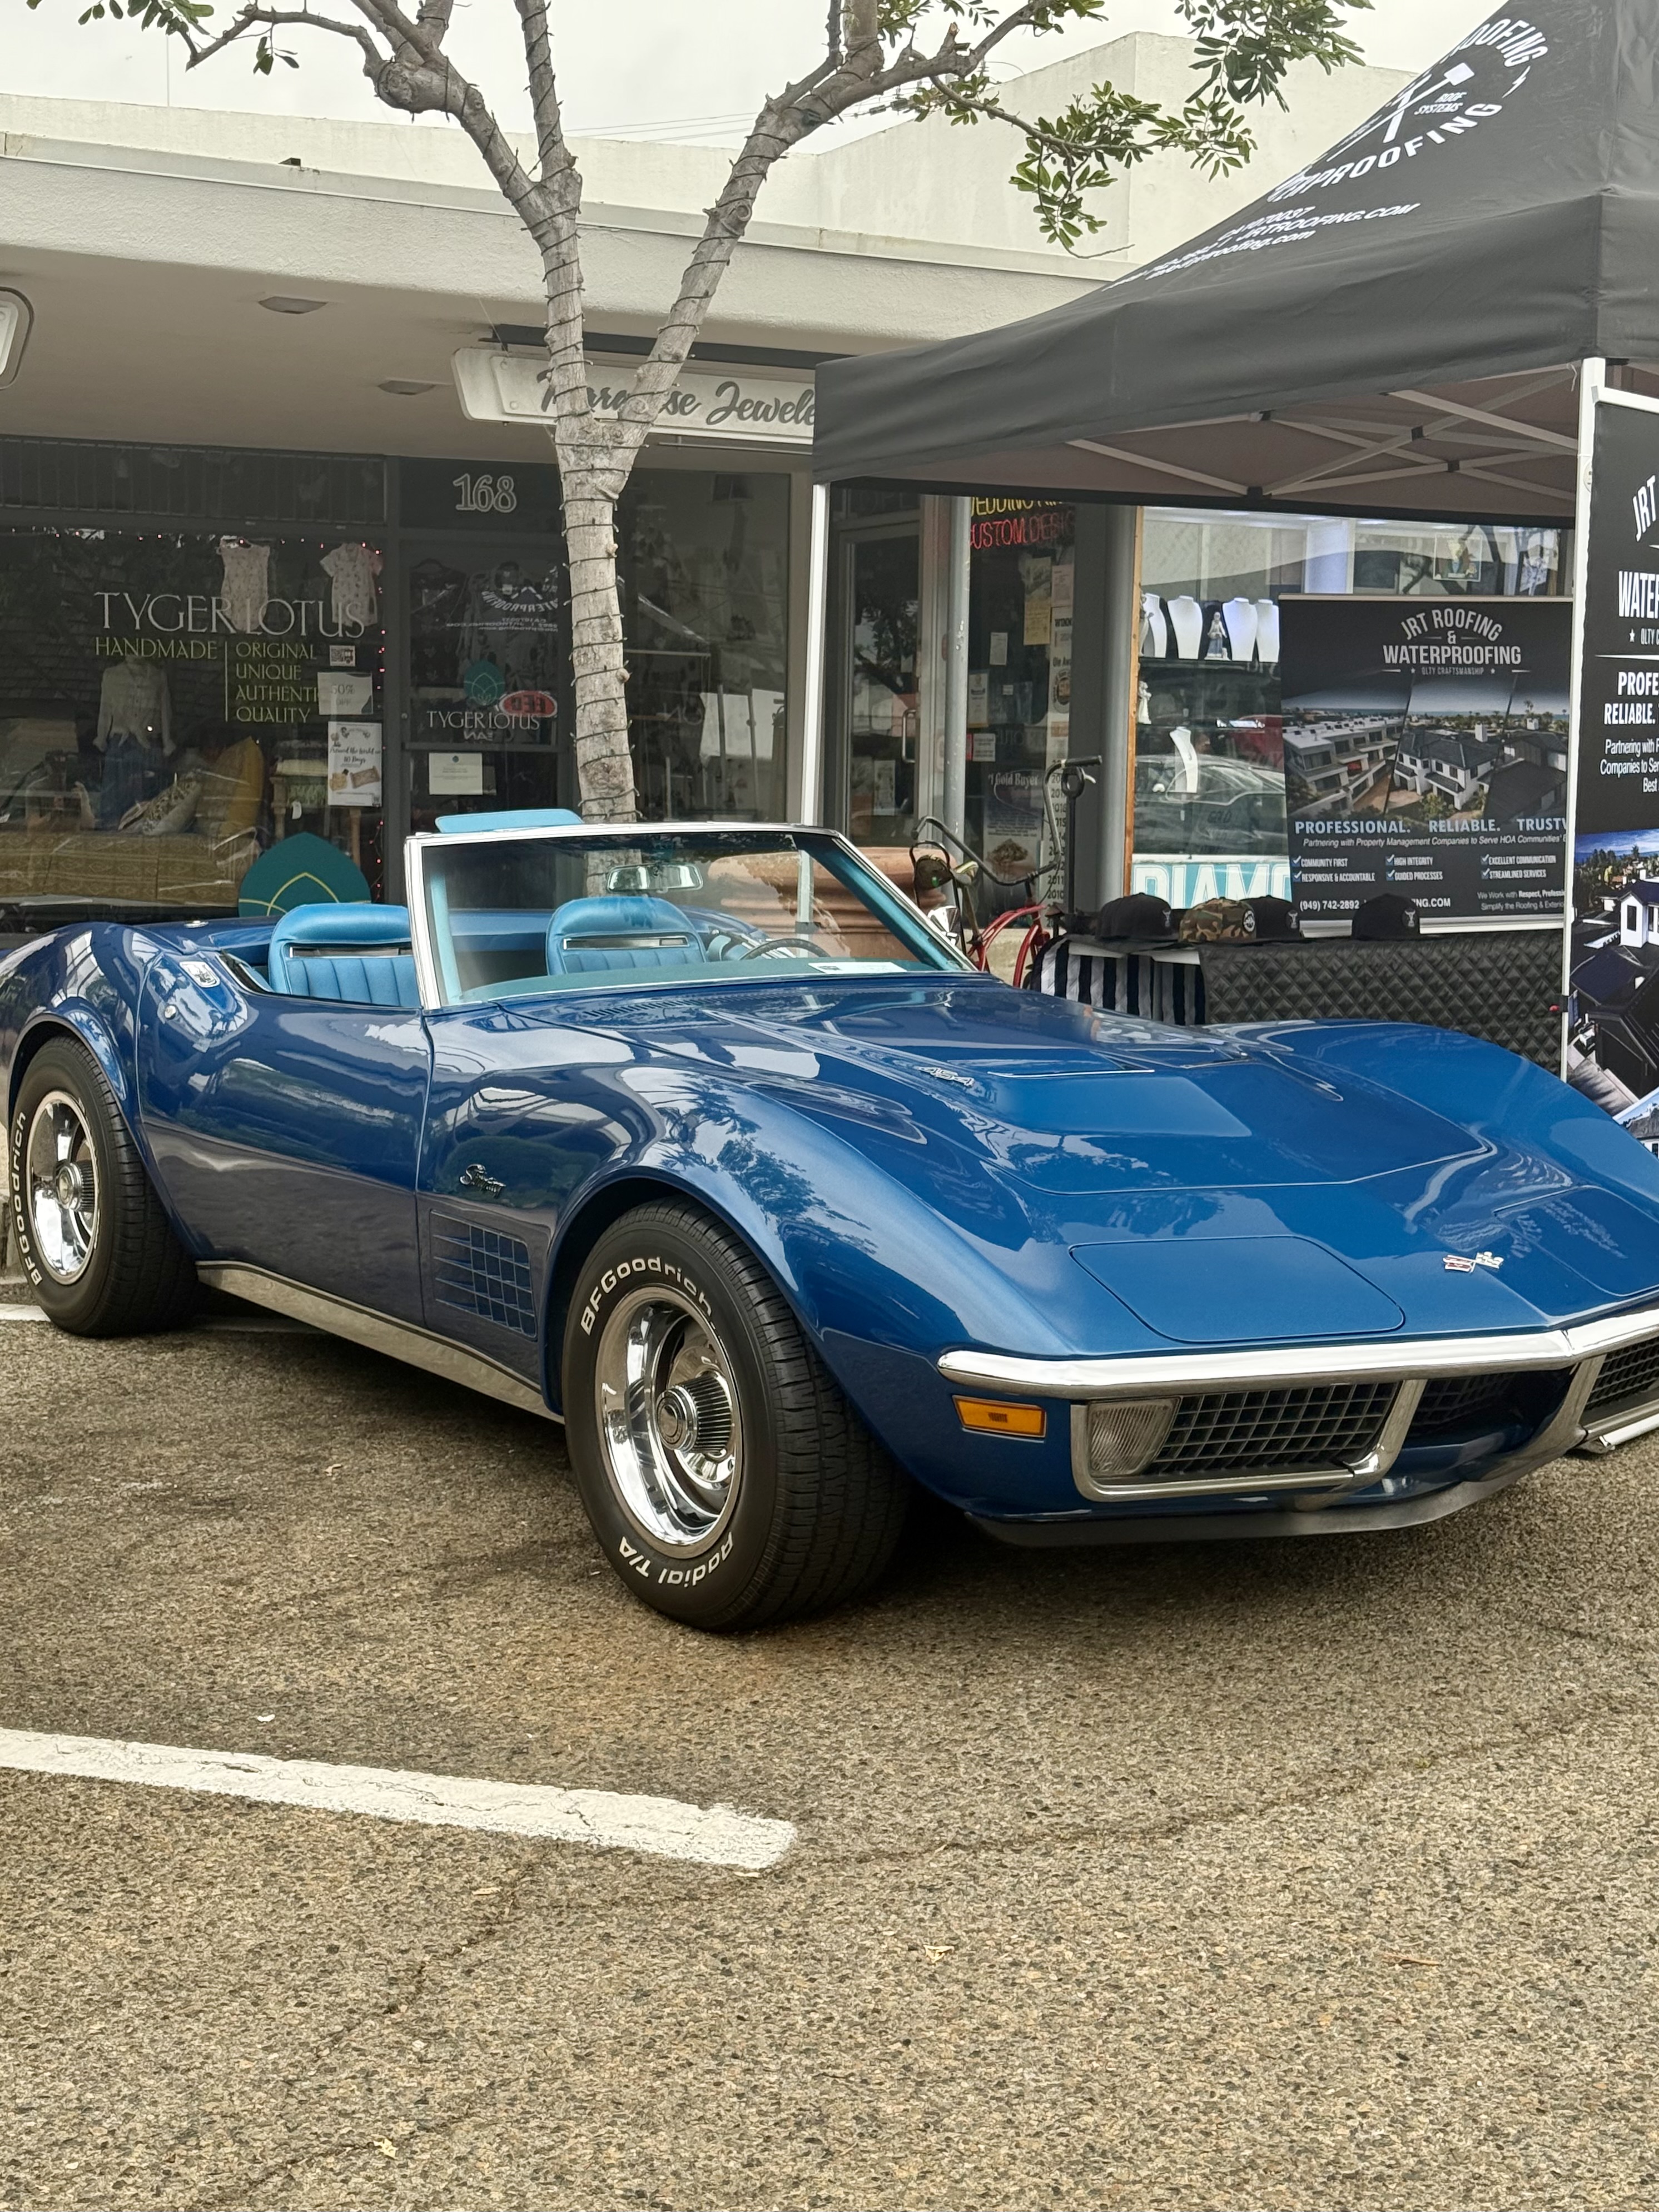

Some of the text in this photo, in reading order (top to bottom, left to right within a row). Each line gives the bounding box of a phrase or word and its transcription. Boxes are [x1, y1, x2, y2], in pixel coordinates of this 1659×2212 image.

[1439, 18, 1548, 67] OOFING
[453, 473, 517, 513] 168
[1632, 474, 1656, 542] JRT
[1618, 570, 1659, 619] WATE
[94, 592, 365, 638] TYGER LOTUS
[1400, 608, 1503, 642] JRT ROOFING
[1447, 630, 1457, 644] &
[1640, 628, 1655, 645] QLTY
[95, 637, 217, 660] HANDMADE
[235, 641, 317, 660] ORIGINAL
[1383, 644, 1522, 665] WATERPROOFING
[235, 663, 302, 681] UNIQUE
[235, 684, 318, 703] AUTHENTI
[236, 706, 311, 724] QUALITY
[426, 710, 485, 729] TYGER
[1603, 703, 1656, 725] RELIABLE.
[1605, 738, 1655, 758] Partnering with
[1600, 758, 1640, 778] Companies
[1641, 759, 1647, 773] to
[1642, 777, 1657, 793] Best
[1295, 820, 1411, 834] PROFESSIONAL.
[1429, 818, 1501, 833] RELIABLE.
[1303, 838, 1339, 849] Partnering
[1340, 837, 1355, 847] with
[1356, 837, 1385, 848] Property
[1386, 837, 1430, 848] Management
[1432, 836, 1469, 847] Companies
[1471, 836, 1478, 844] to
[1479, 835, 1499, 845] Serve
[1499, 834, 1516, 844] HOA
[1300, 858, 1348, 867] COMMUNITY FIRST
[1393, 856, 1433, 866] HIGH INTEGRITY
[1488, 855, 1557, 866] EXCELLENT COMMUNICATION
[1302, 872, 1334, 882] RESPONSIVE
[1339, 872, 1375, 882] ACCOUNTABLE
[1394, 871, 1443, 881] GUIDED PROCESSES
[1489, 869, 1547, 879] STREAMLINED SERVICES
[1489, 891, 1504, 899] Work
[1299, 899, 1321, 912] (949)
[1322, 898, 1360, 910] 742-2892
[13, 1111, 43, 1286] BFGoodrich
[580, 1256, 713, 1336] BFGoodrich
[619, 1531, 733, 1588] Radial T/A
